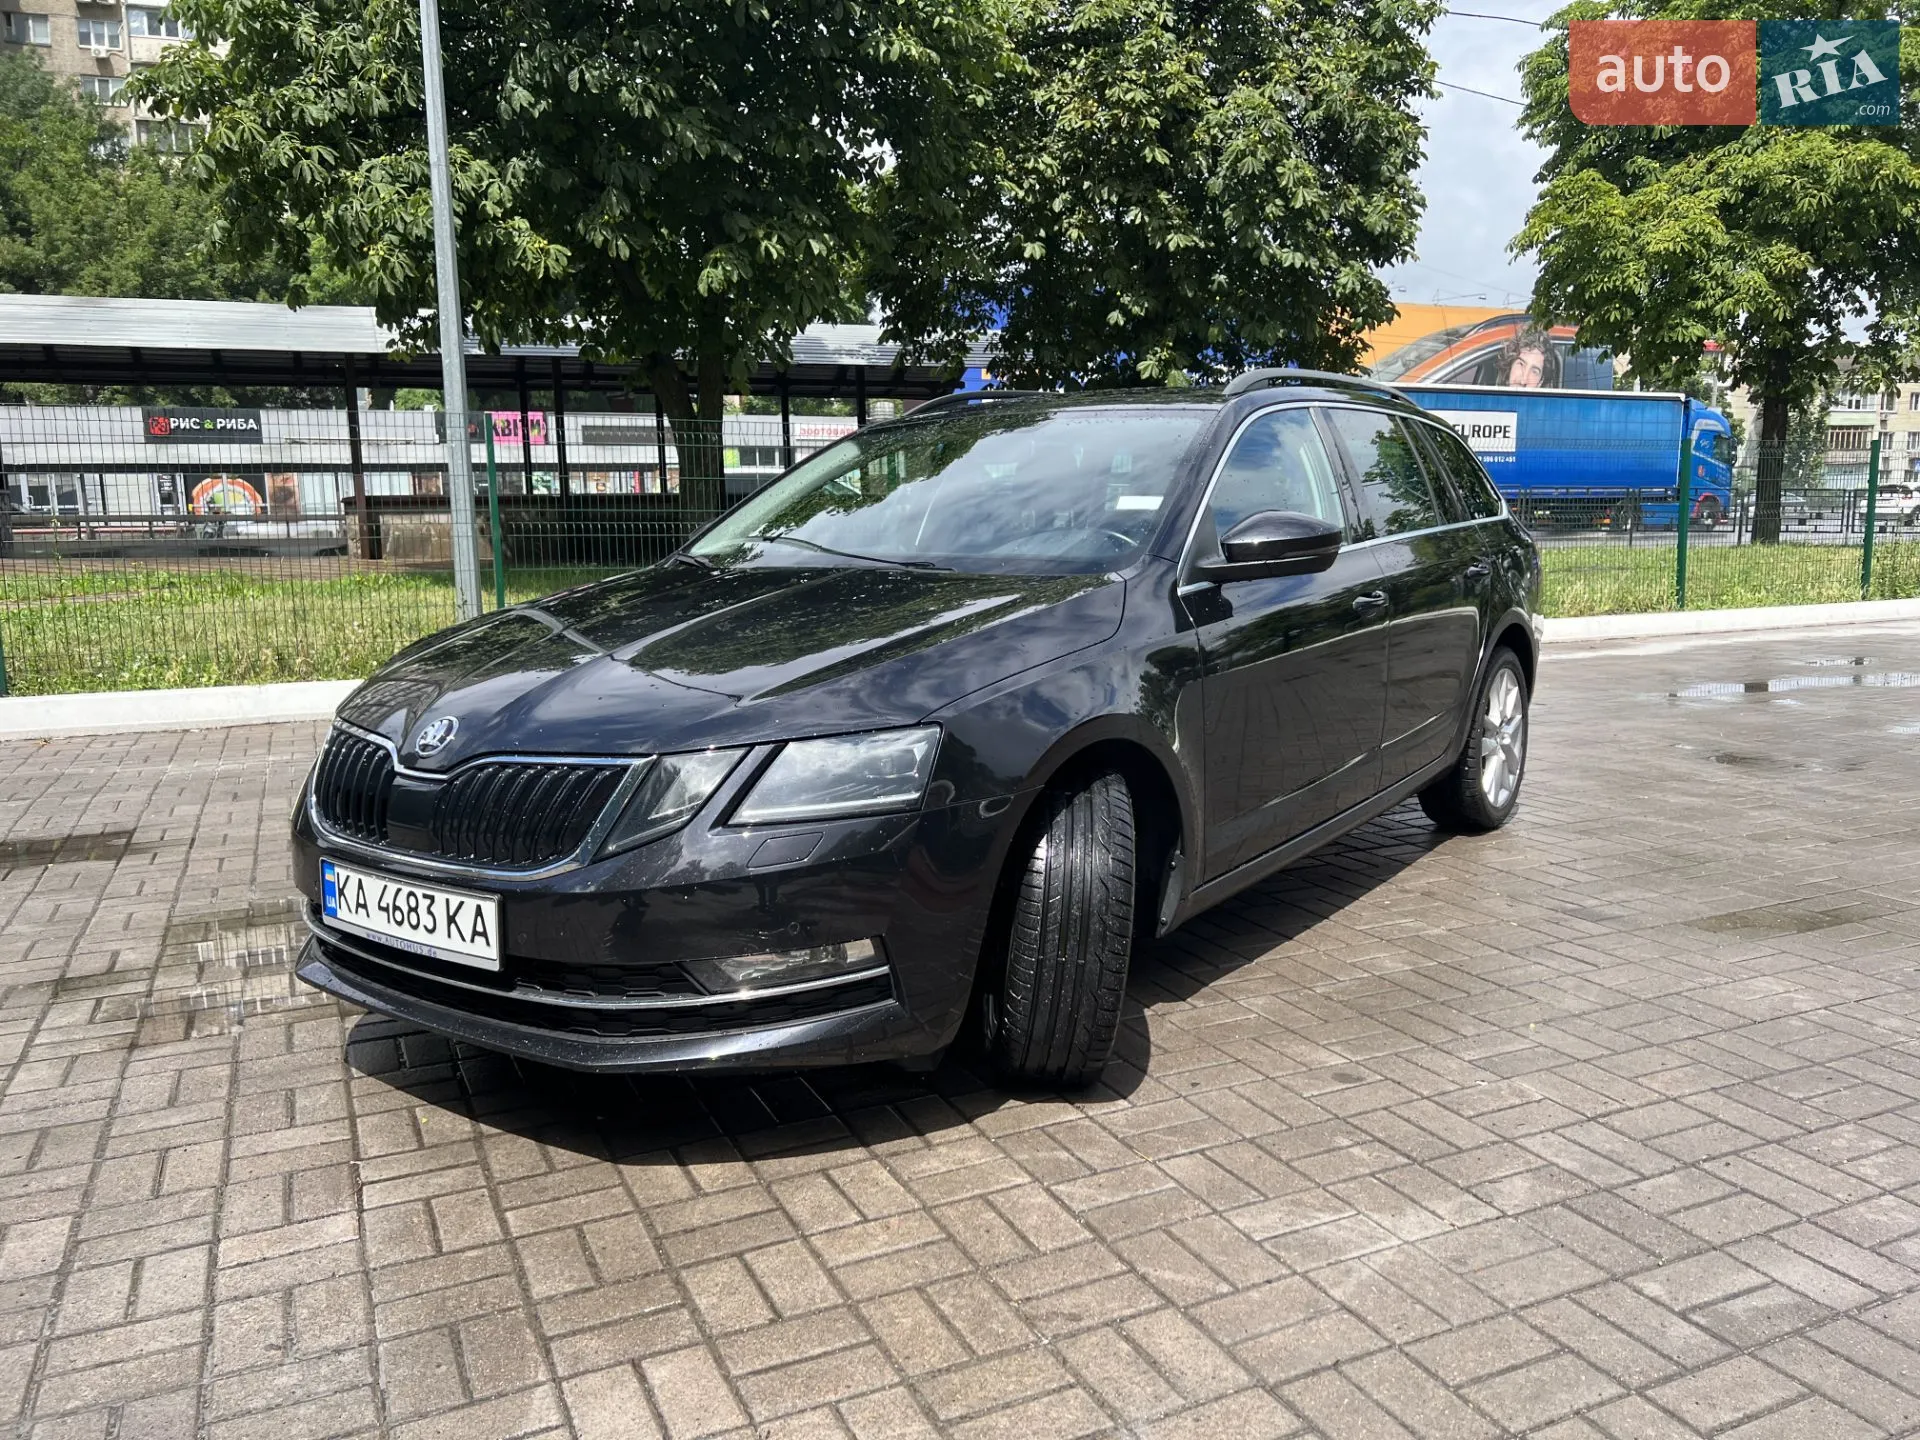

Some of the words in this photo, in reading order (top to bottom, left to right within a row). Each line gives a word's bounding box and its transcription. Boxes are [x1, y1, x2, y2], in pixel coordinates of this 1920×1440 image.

[170, 417, 200, 430] РИС
[216, 418, 258, 430] РИБА
[326, 895, 337, 909] UA
[336, 871, 371, 919] KA
[377, 883, 437, 935] 4683
[445, 897, 491, 948] KA
